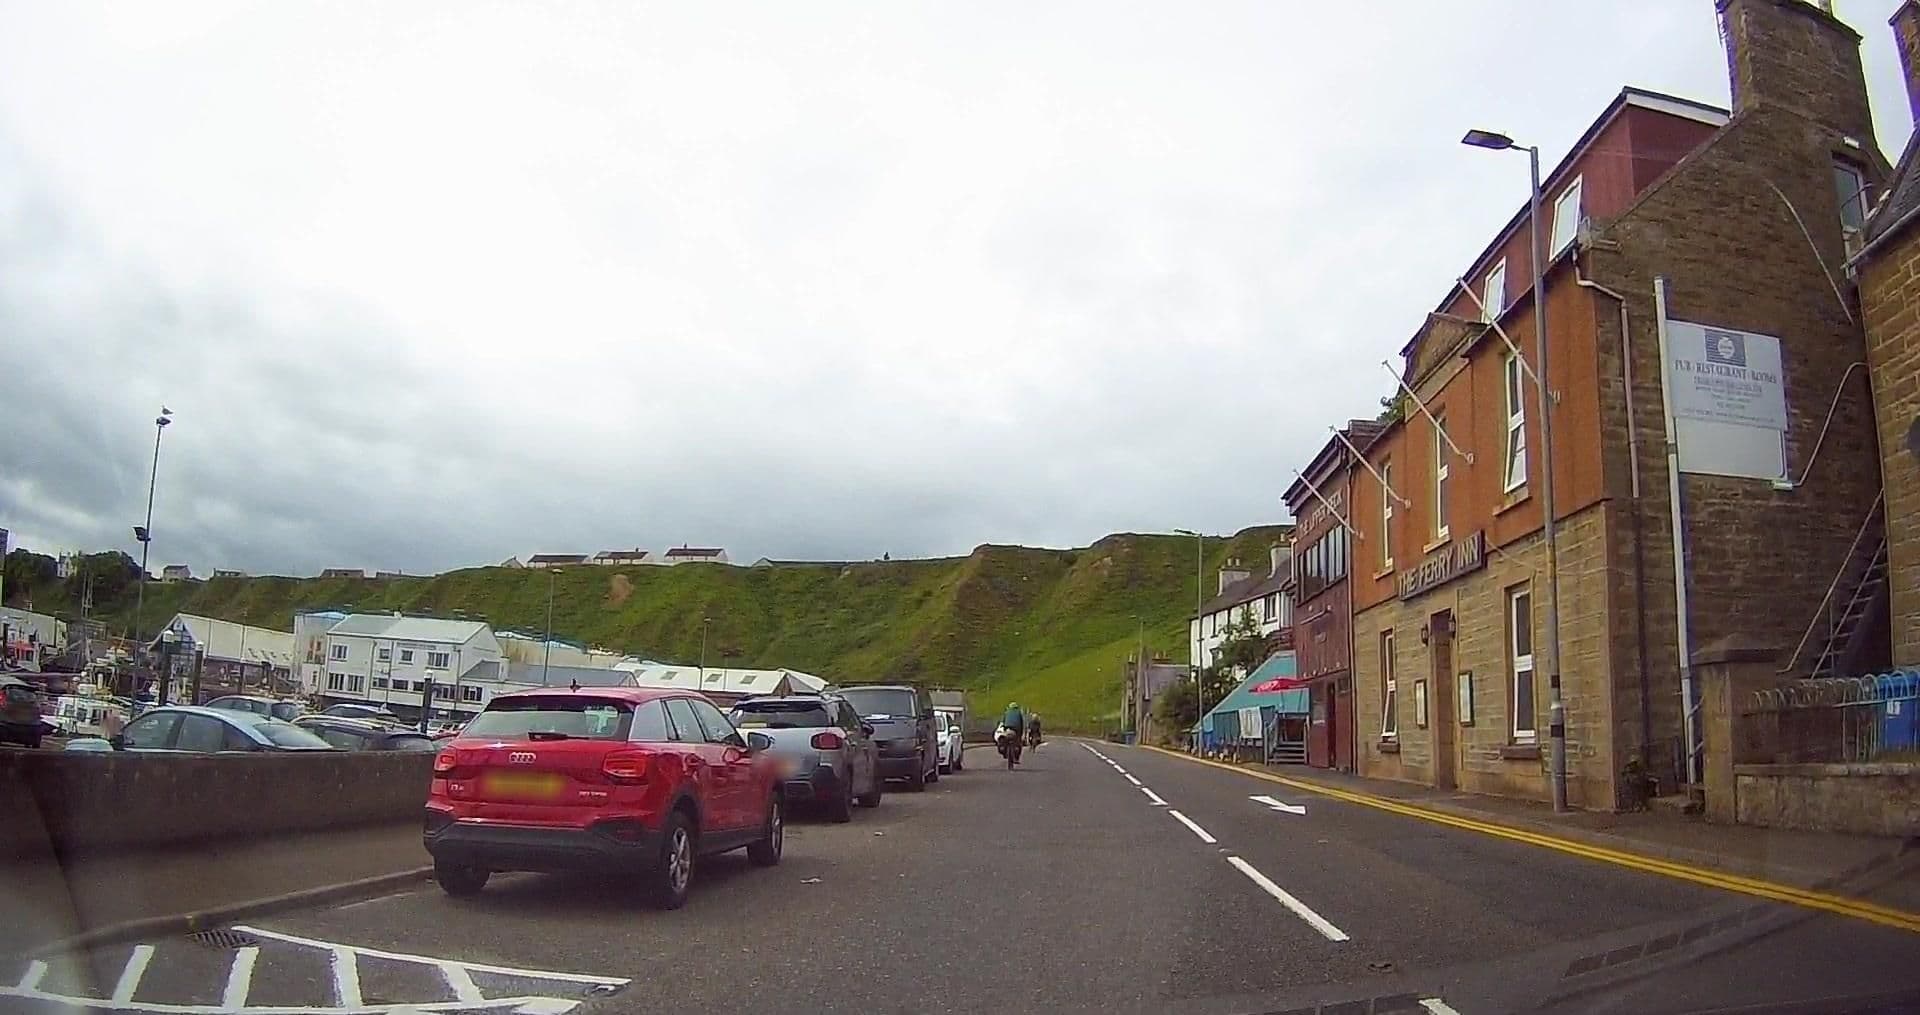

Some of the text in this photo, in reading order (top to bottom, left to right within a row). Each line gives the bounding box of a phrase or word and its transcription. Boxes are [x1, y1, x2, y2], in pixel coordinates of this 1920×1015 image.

[1398, 535, 1479, 597] THE FERRY INN
